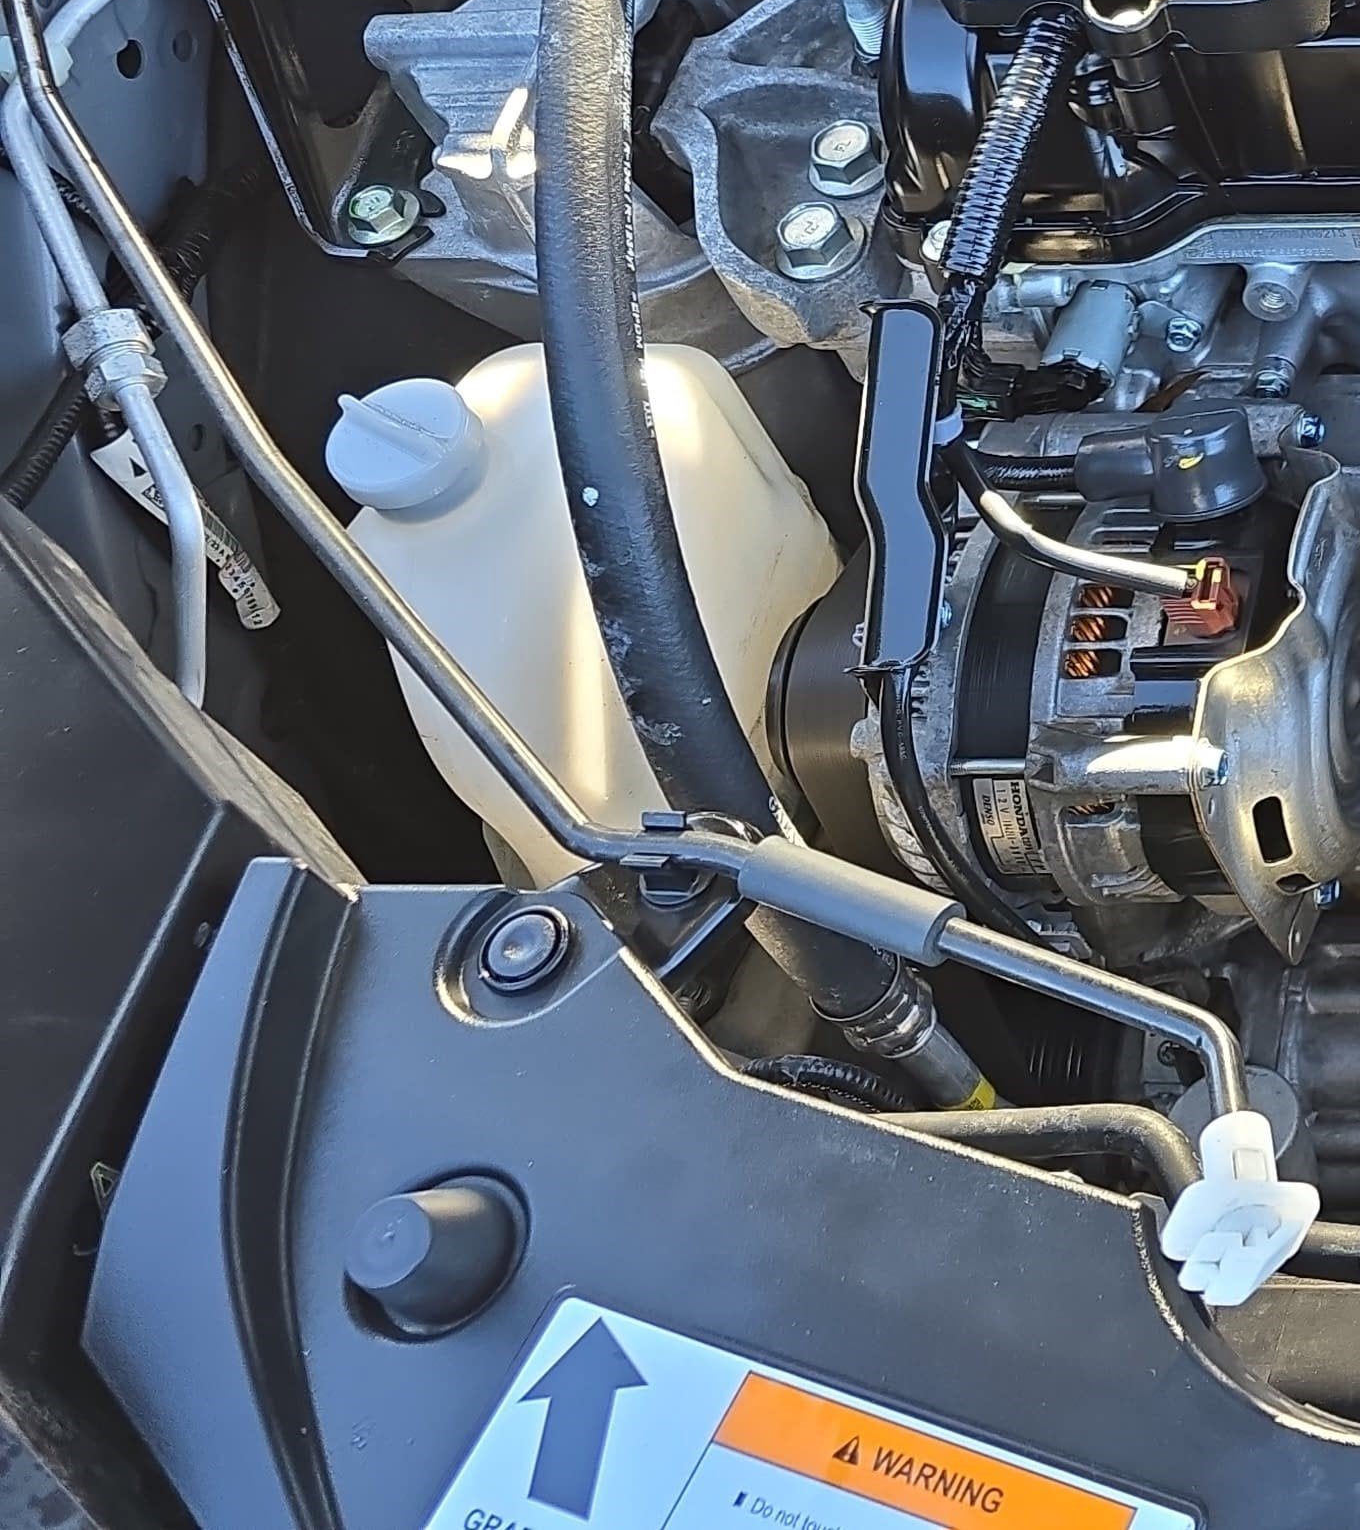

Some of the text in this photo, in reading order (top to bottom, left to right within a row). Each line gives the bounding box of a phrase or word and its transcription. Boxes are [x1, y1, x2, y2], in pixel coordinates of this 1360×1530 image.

[982, 795, 995, 826] DENSO
[1011, 781, 1029, 837] HONDA
[872, 1444, 1005, 1515] WARNING
[750, 1497, 773, 1518] Do
[774, 1509, 801, 1529] not
